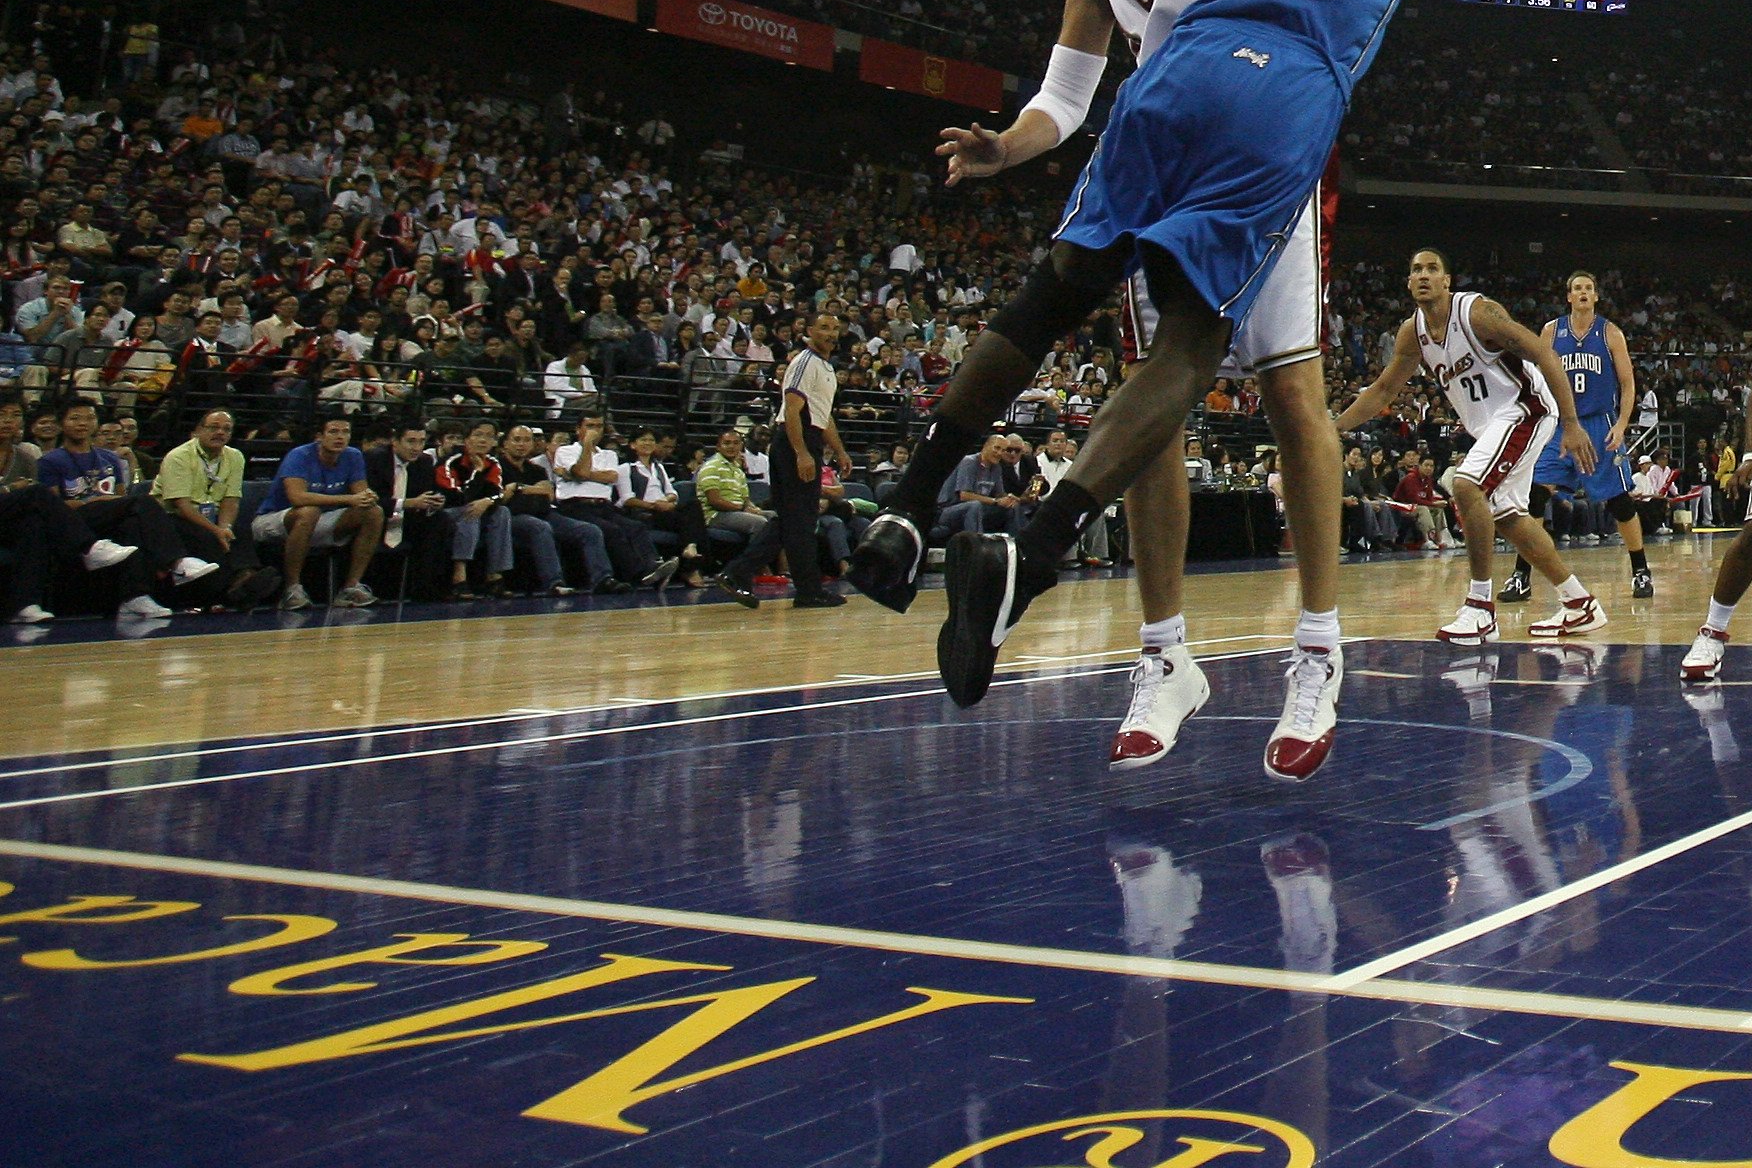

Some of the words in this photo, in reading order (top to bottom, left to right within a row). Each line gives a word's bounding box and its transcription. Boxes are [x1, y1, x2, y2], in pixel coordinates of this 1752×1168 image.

[727, 10, 799, 42] TOYOTA
[1557, 352, 1602, 375] RLANDO
[1459, 373, 1489, 402] 27
[1574, 372, 1586, 394] 8
